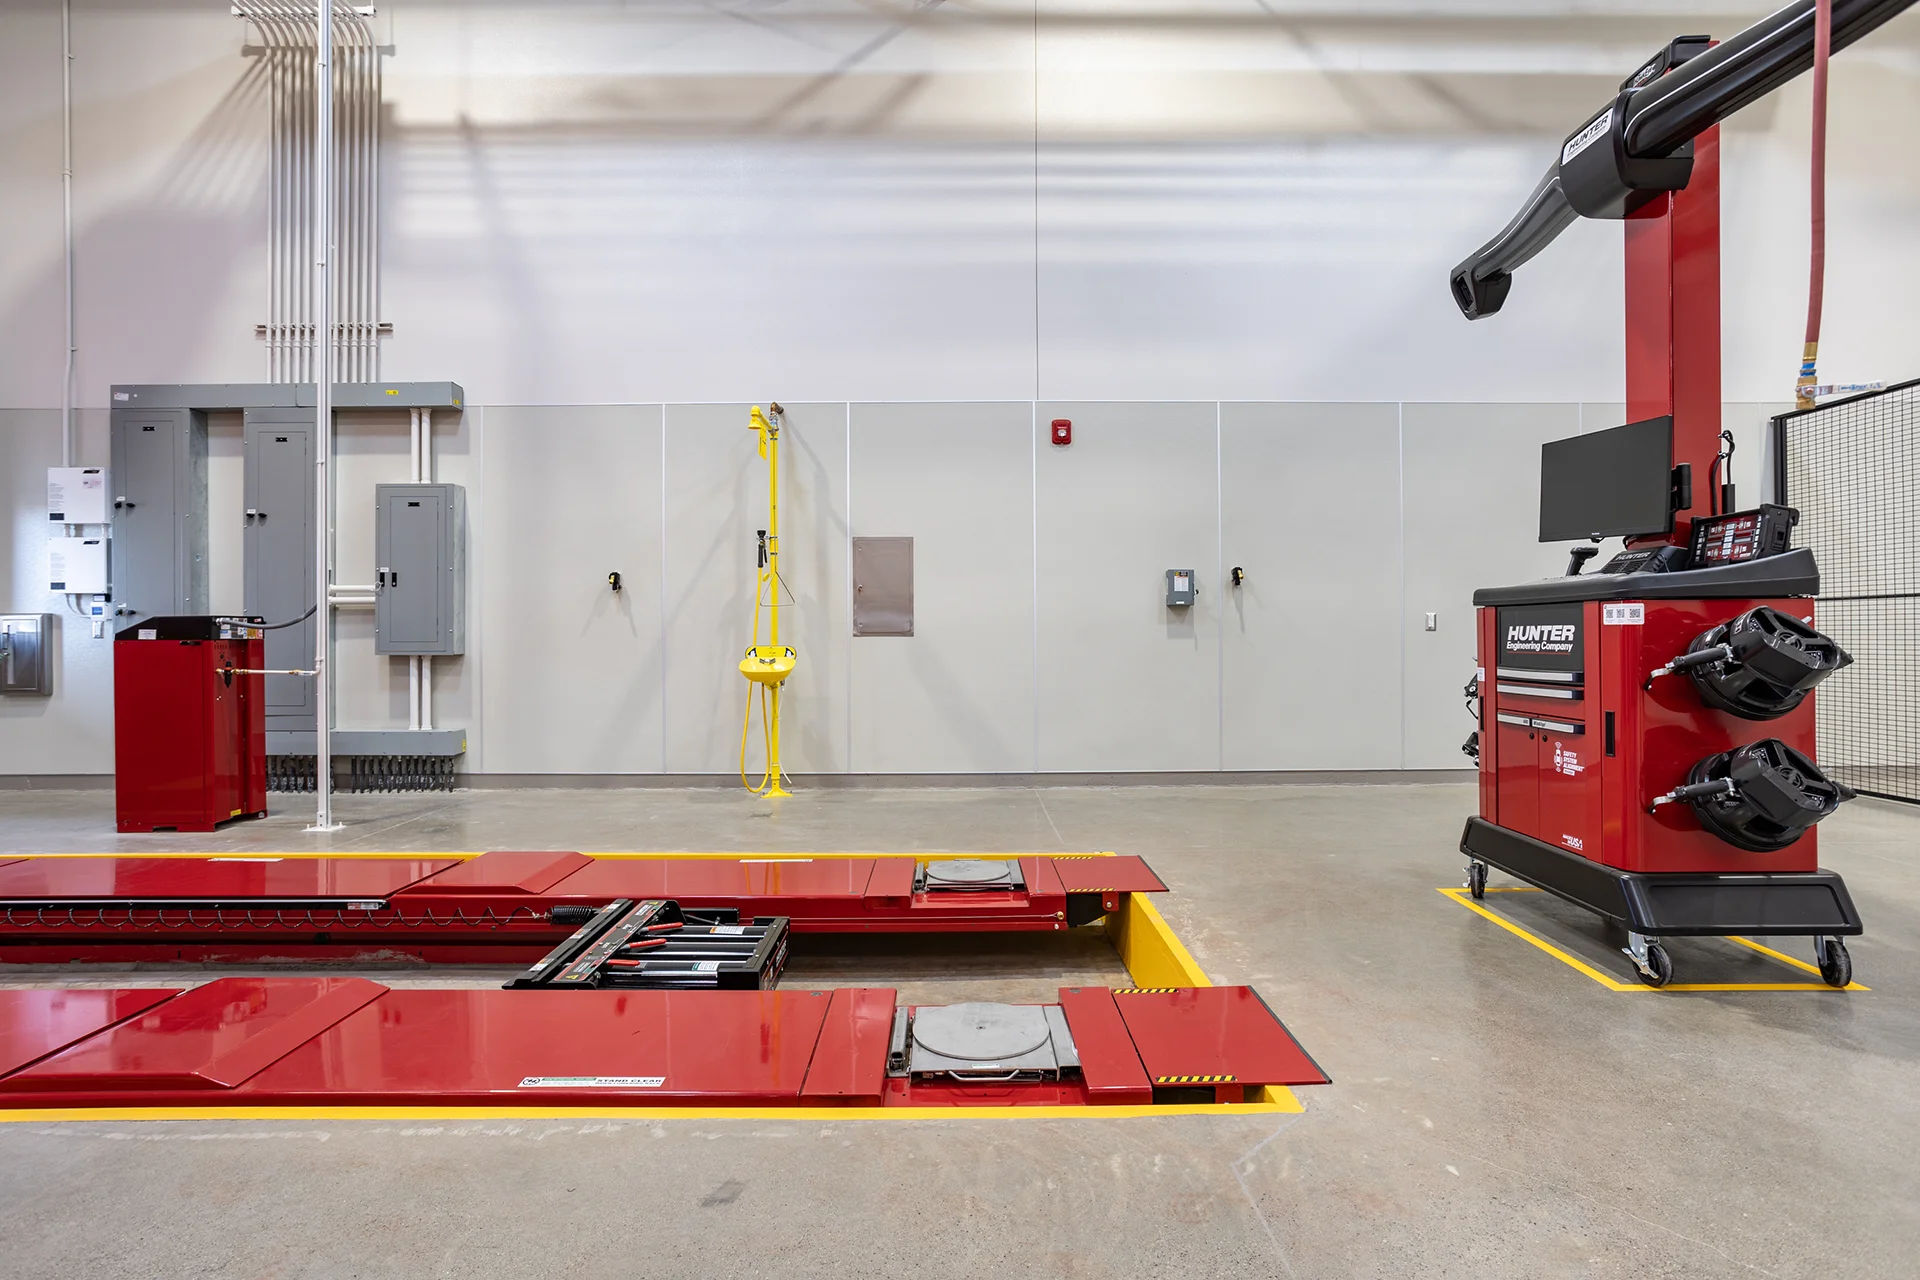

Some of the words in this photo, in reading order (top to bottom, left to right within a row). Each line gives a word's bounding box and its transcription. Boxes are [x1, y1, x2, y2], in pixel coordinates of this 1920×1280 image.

[1568, 114, 1609, 151] HUNTER
[1615, 552, 1651, 561] HUNTER
[1507, 625, 1576, 641] HUNTER
[1506, 641, 1541, 652] Engineering
[1541, 641, 1574, 653] Company
[1571, 837, 1583, 849] USA
